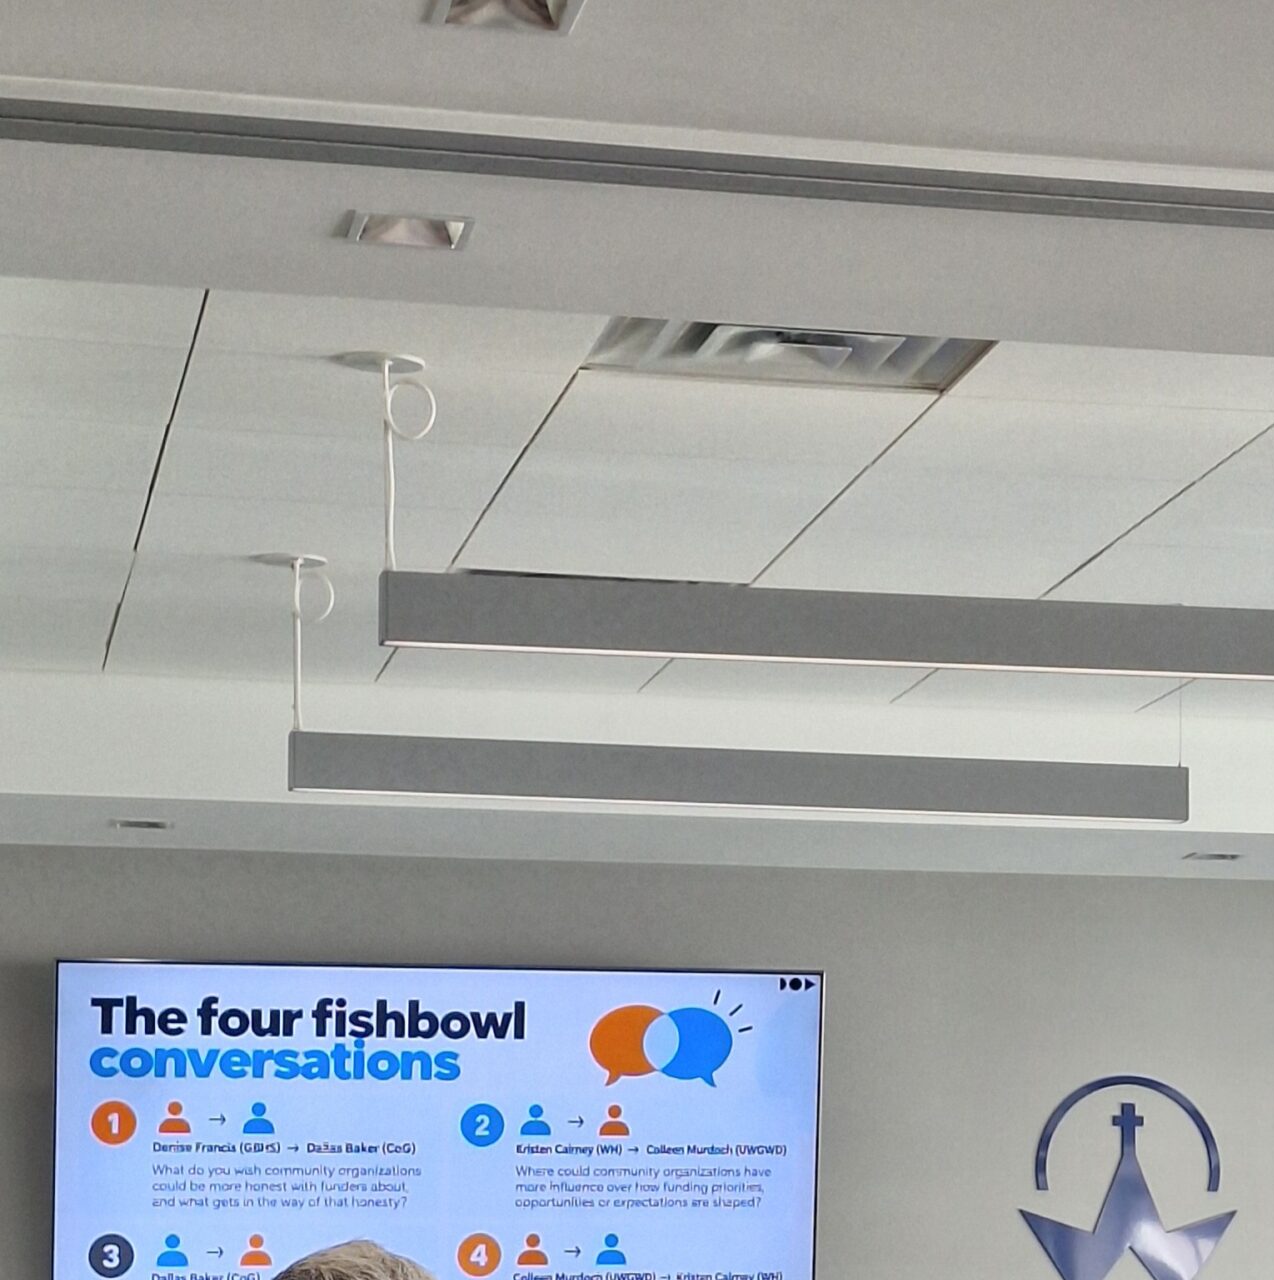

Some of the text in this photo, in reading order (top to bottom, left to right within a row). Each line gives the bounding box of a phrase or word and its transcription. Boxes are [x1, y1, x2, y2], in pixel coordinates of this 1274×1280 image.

[91, 996, 525, 1040] The four fishbowl
[90, 1038, 460, 1081] conversations
[107, 1113, 120, 1134] 1
[475, 1115, 490, 1136] 2
[195, 1142, 236, 1153] Francis
[345, 1142, 379, 1153] Baker
[382, 1142, 416, 1155] (CoG)
[596, 1144, 622, 1156] (WH)
[646, 1145, 684, 1155] Colleen
[687, 1144, 733, 1155] Murdoch
[735, 1144, 787, 1157] (UWGWD)
[152, 1164, 422, 1178] What do you wish community organizations
[515, 1165, 772, 1179] Where could community organizations have
[152, 1181, 186, 1191] could
[190, 1181, 205, 1191] be
[209, 1183, 241, 1191] more
[245, 1181, 287, 1191] honest
[291, 1182, 317, 1192] with
[321, 1182, 367, 1192] funders
[515, 1181, 764, 1195] more influence over how funding priorities,
[152, 1196, 408, 1209] and what gets in the way of that honesty?
[515, 1197, 761, 1209] opportunities or expectations are shaped?
[102, 1244, 120, 1268] 3
[470, 1244, 488, 1266] 4
